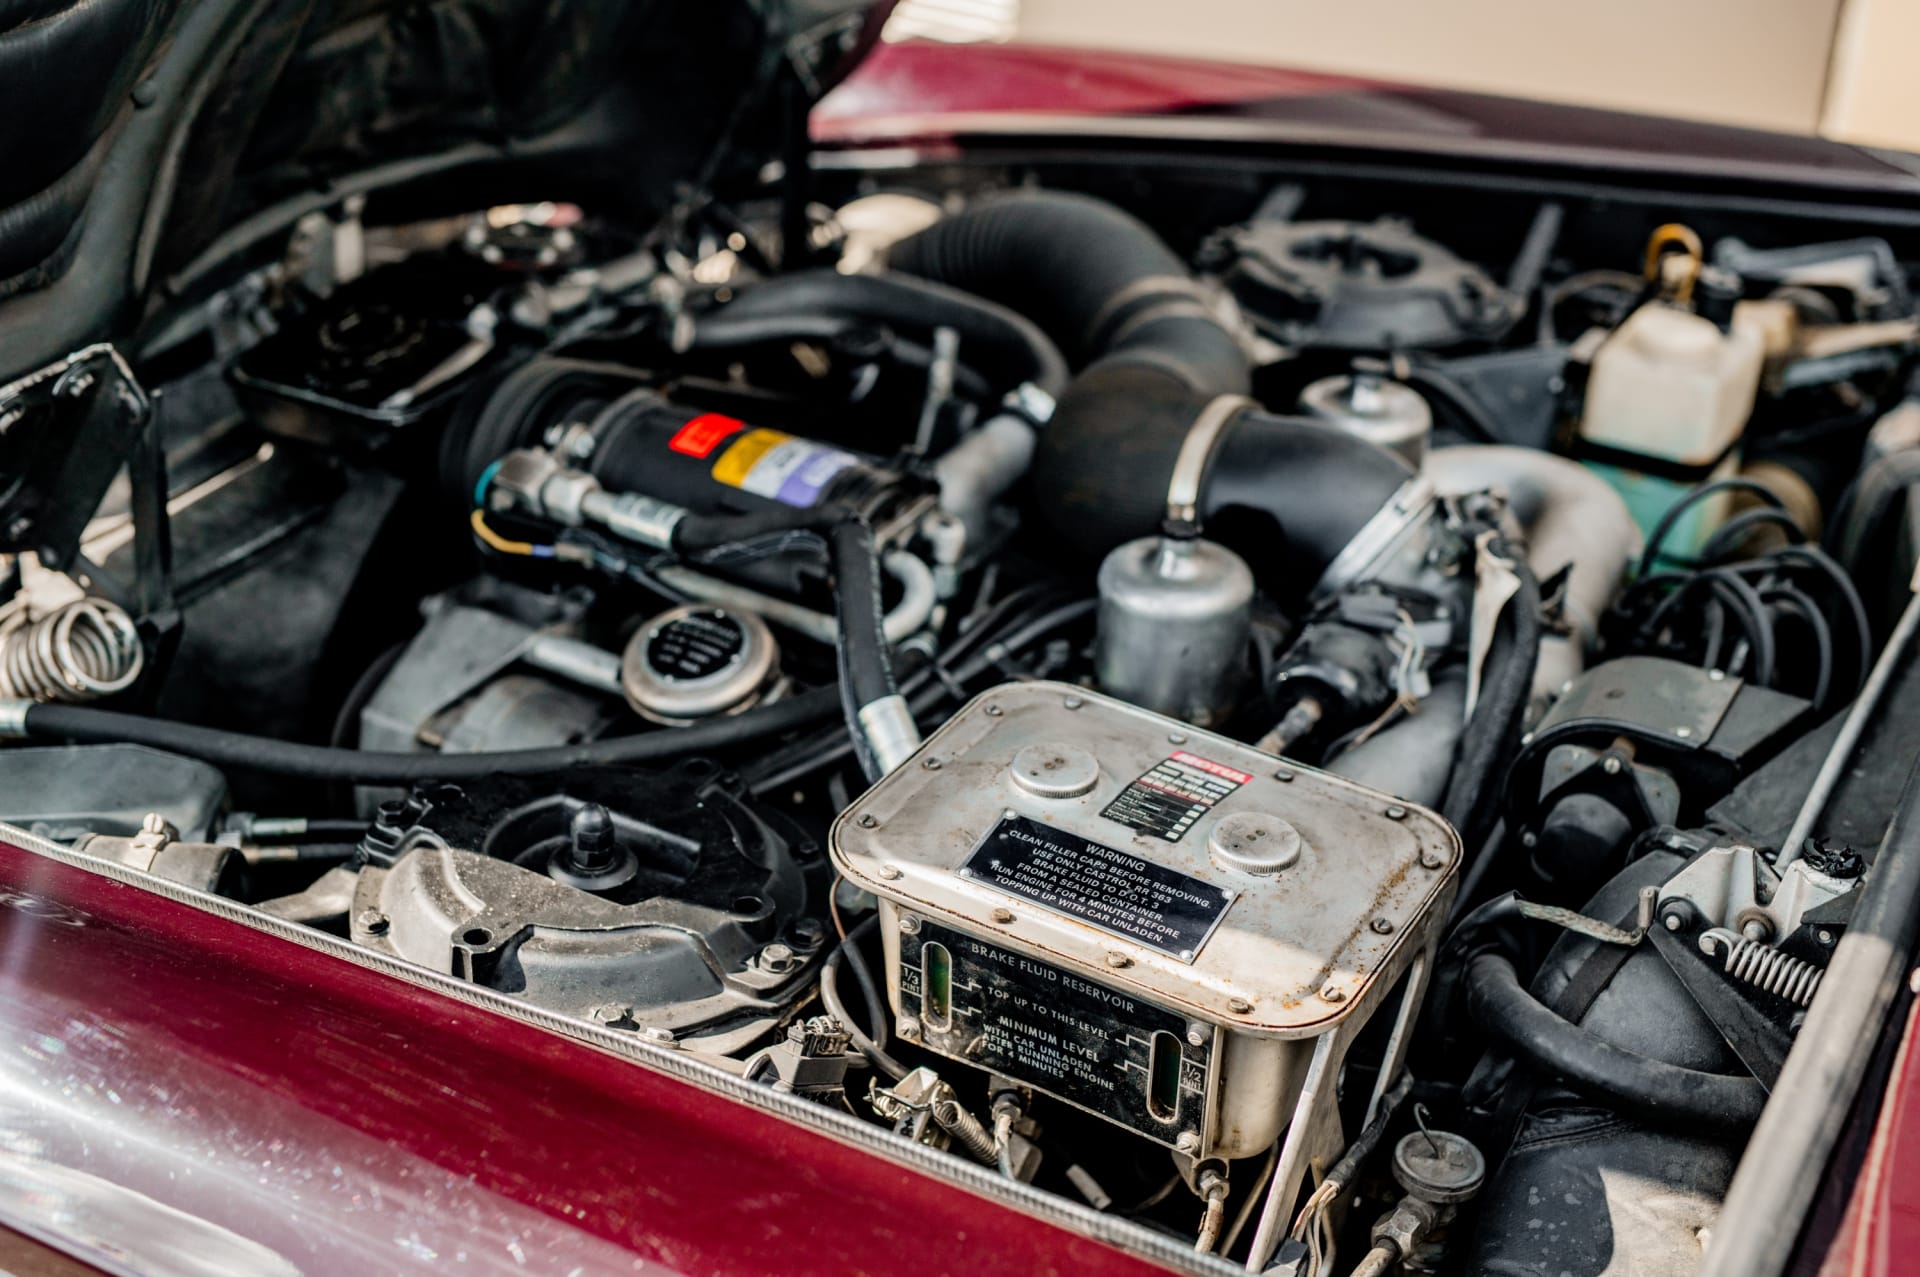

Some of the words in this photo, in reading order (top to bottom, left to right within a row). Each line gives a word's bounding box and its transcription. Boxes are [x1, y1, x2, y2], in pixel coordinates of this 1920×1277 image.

[1009, 830, 1043, 847] CLEAN
[1043, 842, 1078, 859] FILLER
[1079, 855, 1107, 870] CAPS
[1109, 866, 1151, 886] BEFORE
[1152, 881, 1211, 909] REMOVING.
[1032, 848, 1054, 860] USE
[1055, 856, 1082, 871] ONLY
[1084, 867, 1131, 889] CASTROL
[1134, 885, 1150, 896] RR
[1151, 892, 1172, 904] 363
[1032, 858, 1068, 875] BRAKE
[1069, 871, 1100, 887] FLUID
[1102, 883, 1117, 894] TO
[1118, 889, 1149, 906] D.O.T.
[1151, 902, 1160, 910] 3
[1085, 843, 1146, 872] WARNING
[990, 863, 1014, 875] RUN
[1015, 872, 1055, 890] ENGINE
[1055, 886, 1078, 900] FOR
[1079, 895, 1087, 903] 4
[1087, 899, 1136, 921] MINUTES
[1137, 918, 1181, 939] BEFORE
[994, 875, 1040, 896] TOPPING
[1041, 892, 1057, 902] UP
[1057, 898, 1086, 913] WITH
[1087, 909, 1110, 922] CAR
[1112, 918, 1164, 944] UNLADEN.
[1016, 862, 1049, 878] FROM
[1049, 875, 1057, 883] A
[1059, 878, 1100, 898] SEALED
[1102, 894, 1165, 923] CONTAINER.
[902, 981, 921, 994] PINT
[903, 967, 919, 985] 1/3
[971, 943, 1015, 967] BRAKE
[1019, 960, 1057, 981] FLUID
[1062, 976, 1135, 1014] RESERVOIR
[988, 986, 1009, 1000] TOP
[1014, 996, 1028, 1007] UP
[1032, 1003, 1047, 1015] TO
[1051, 1010, 1075, 1026] THIS
[1079, 1020, 1110, 1040] LEVEL
[999, 1015, 1058, 1045] MINIMUM
[1062, 1039, 1100, 1063] LEVEL
[982, 1041, 1004, 1056] FOR
[1008, 1051, 1014, 1059] 4
[1018, 1054, 1065, 1079] MINUTES
[983, 1024, 1009, 1039] WITH
[1013, 1035, 1035, 1049] CAR
[1039, 1045, 1092, 1072] UNLADEN
[983, 1033, 1013, 1050] AFTER
[1017, 1045, 1070, 1072] RUNNING
[1074, 1068, 1115, 1091] ENGINE
[1185, 1063, 1201, 1082] 1/2
